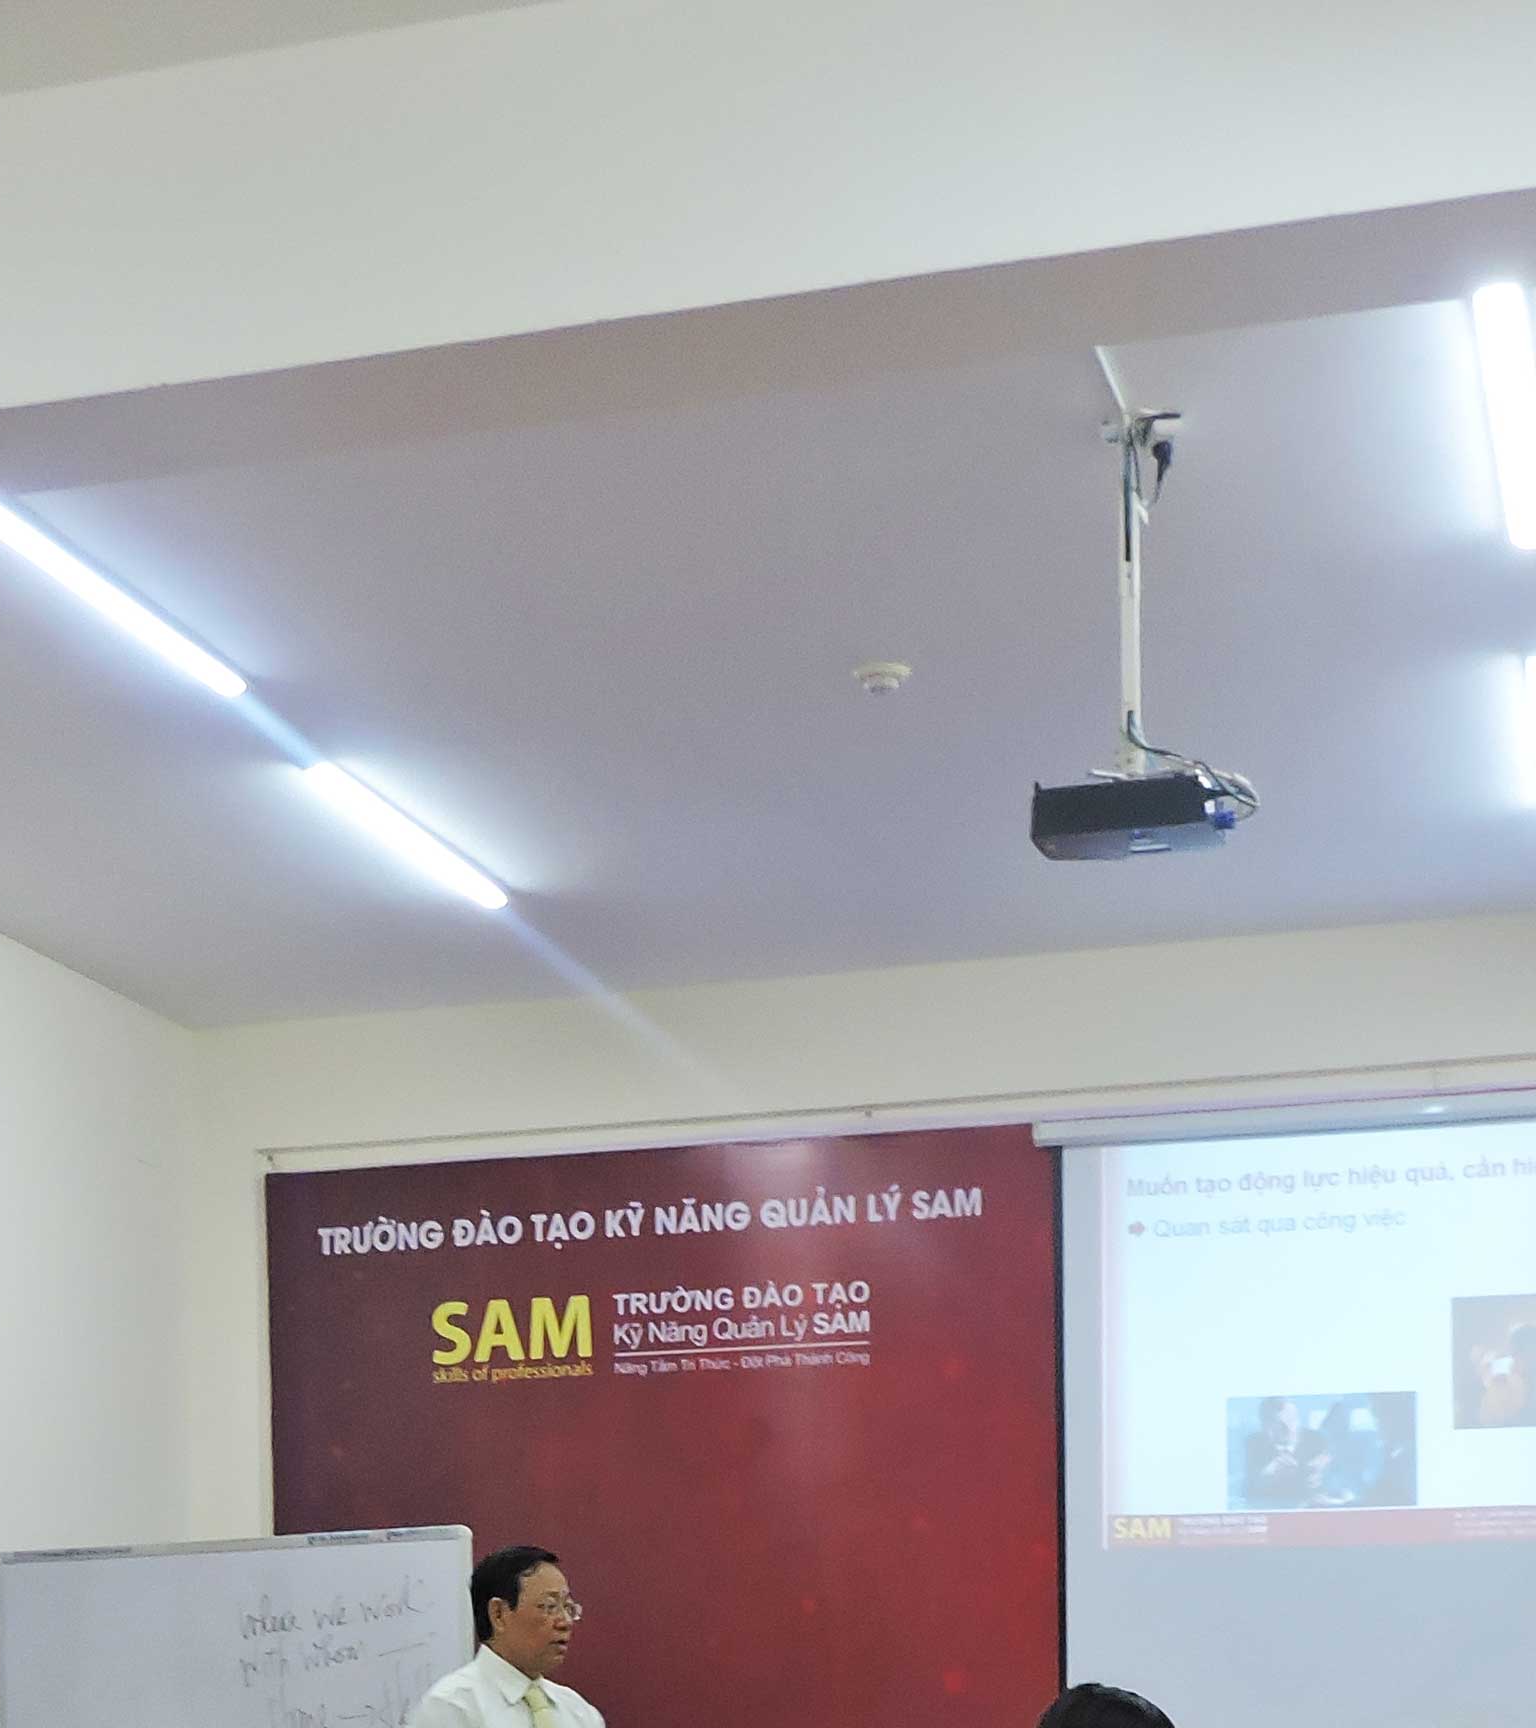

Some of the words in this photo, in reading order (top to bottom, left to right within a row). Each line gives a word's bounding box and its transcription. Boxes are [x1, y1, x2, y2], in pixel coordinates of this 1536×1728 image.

[1196, 1176, 1232, 1199] tạo
[1239, 1170, 1296, 1197] động
[1303, 1169, 1341, 1195] lực
[1348, 1163, 1397, 1191] hiệu
[317, 1215, 445, 1256] TRƯỜNG
[452, 1209, 524, 1247] ĐÀO
[529, 1210, 596, 1250] TẠO
[604, 1201, 646, 1238] KỸ
[654, 1197, 752, 1236] NĂNG
[759, 1186, 857, 1229] QUẢN
[866, 1184, 902, 1223] LÝ
[912, 1187, 983, 1220] SAM
[1153, 1217, 1211, 1239] Quan
[1256, 1215, 1298, 1239] qua
[612, 1285, 735, 1316] TRƯỜNG
[742, 1279, 804, 1309] ĐÀO
[811, 1280, 871, 1309] TẠO
[431, 1294, 593, 1366] SAM
[613, 1322, 643, 1350] Kỹ
[647, 1320, 709, 1348] Năng
[712, 1315, 776, 1341] Quản
[780, 1312, 809, 1342] Lý
[812, 1310, 871, 1335] SAM
[432, 1365, 469, 1384] skills
[471, 1364, 489, 1382] of
[490, 1360, 595, 1384] professionals
[1114, 1516, 1173, 1540] SAM
